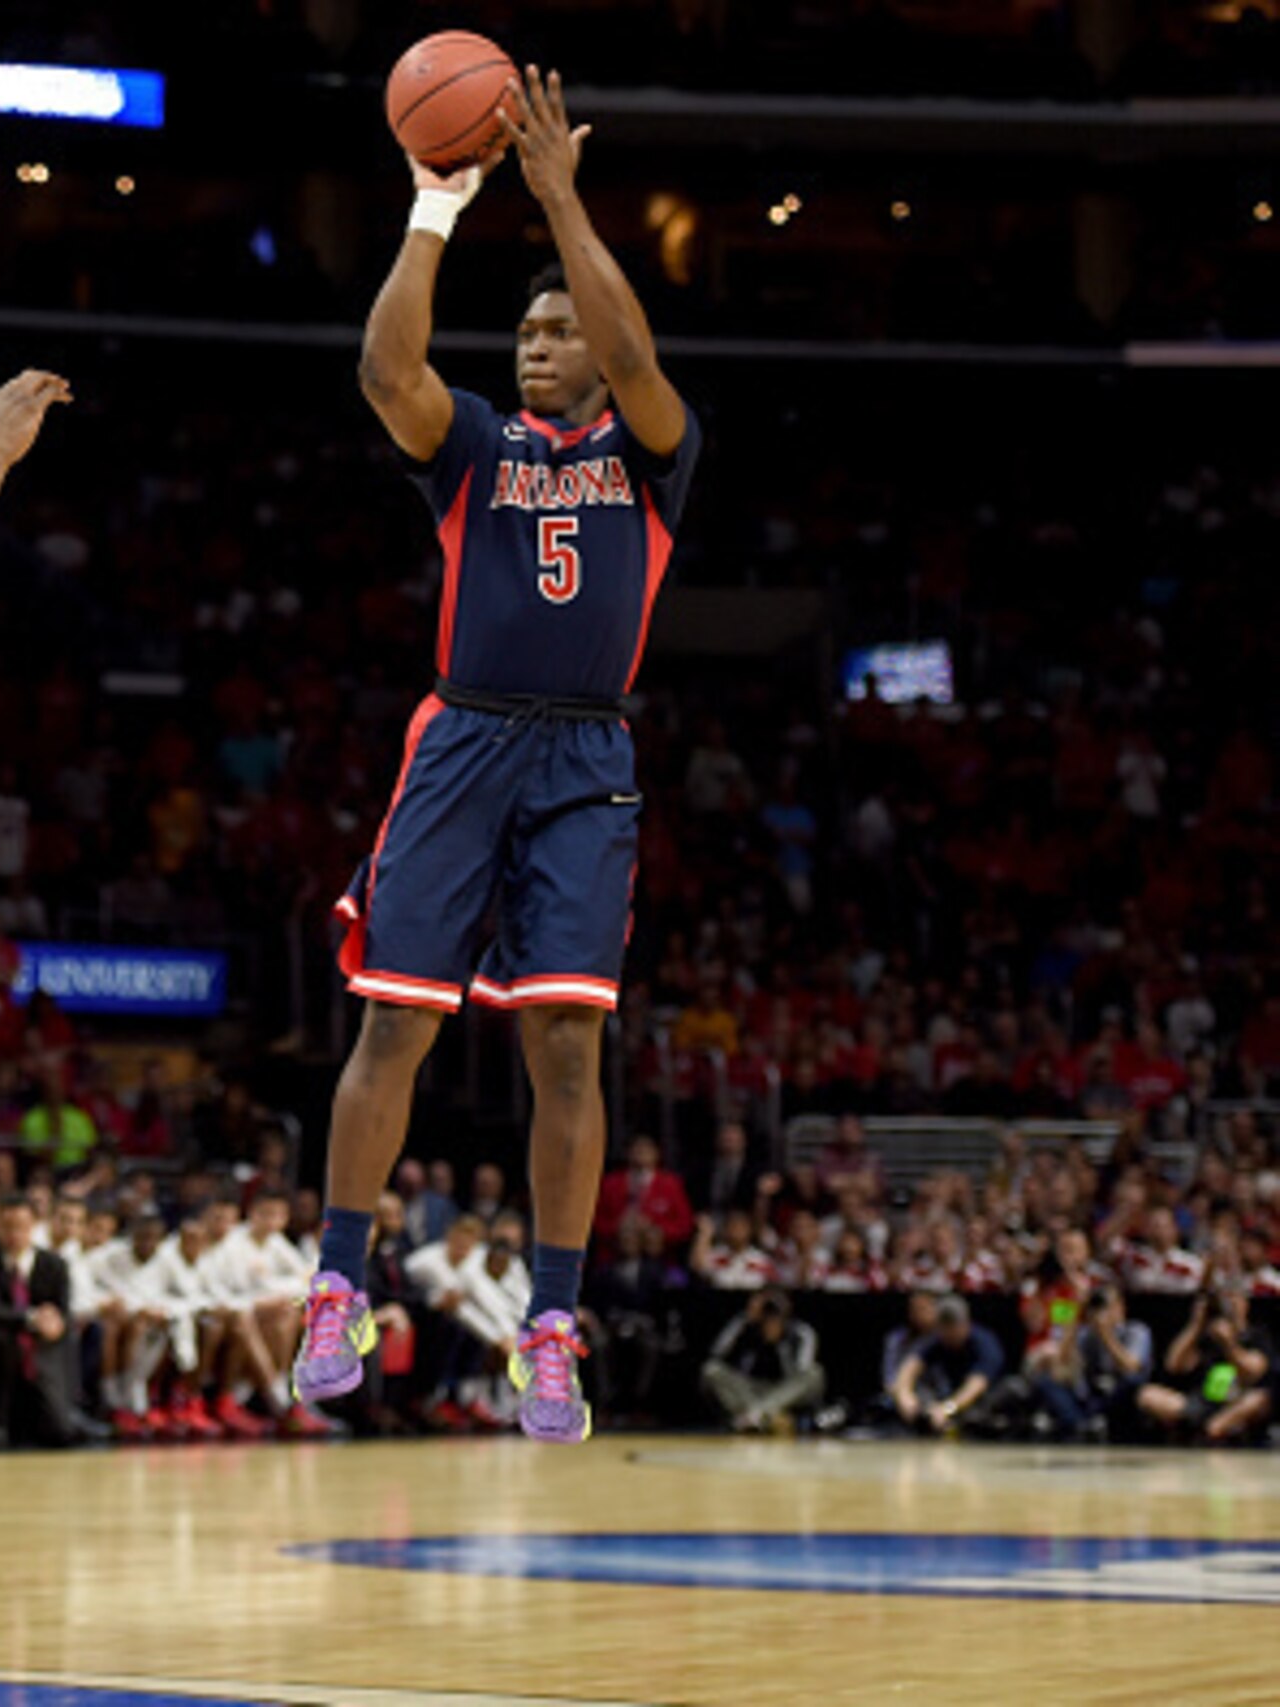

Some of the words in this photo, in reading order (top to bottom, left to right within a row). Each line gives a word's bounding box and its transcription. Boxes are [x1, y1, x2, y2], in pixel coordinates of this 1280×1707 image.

[490, 456, 634, 511] ARIZONA
[537, 516, 580, 604] 5
[38, 955, 215, 1001] UNIVERSITY
